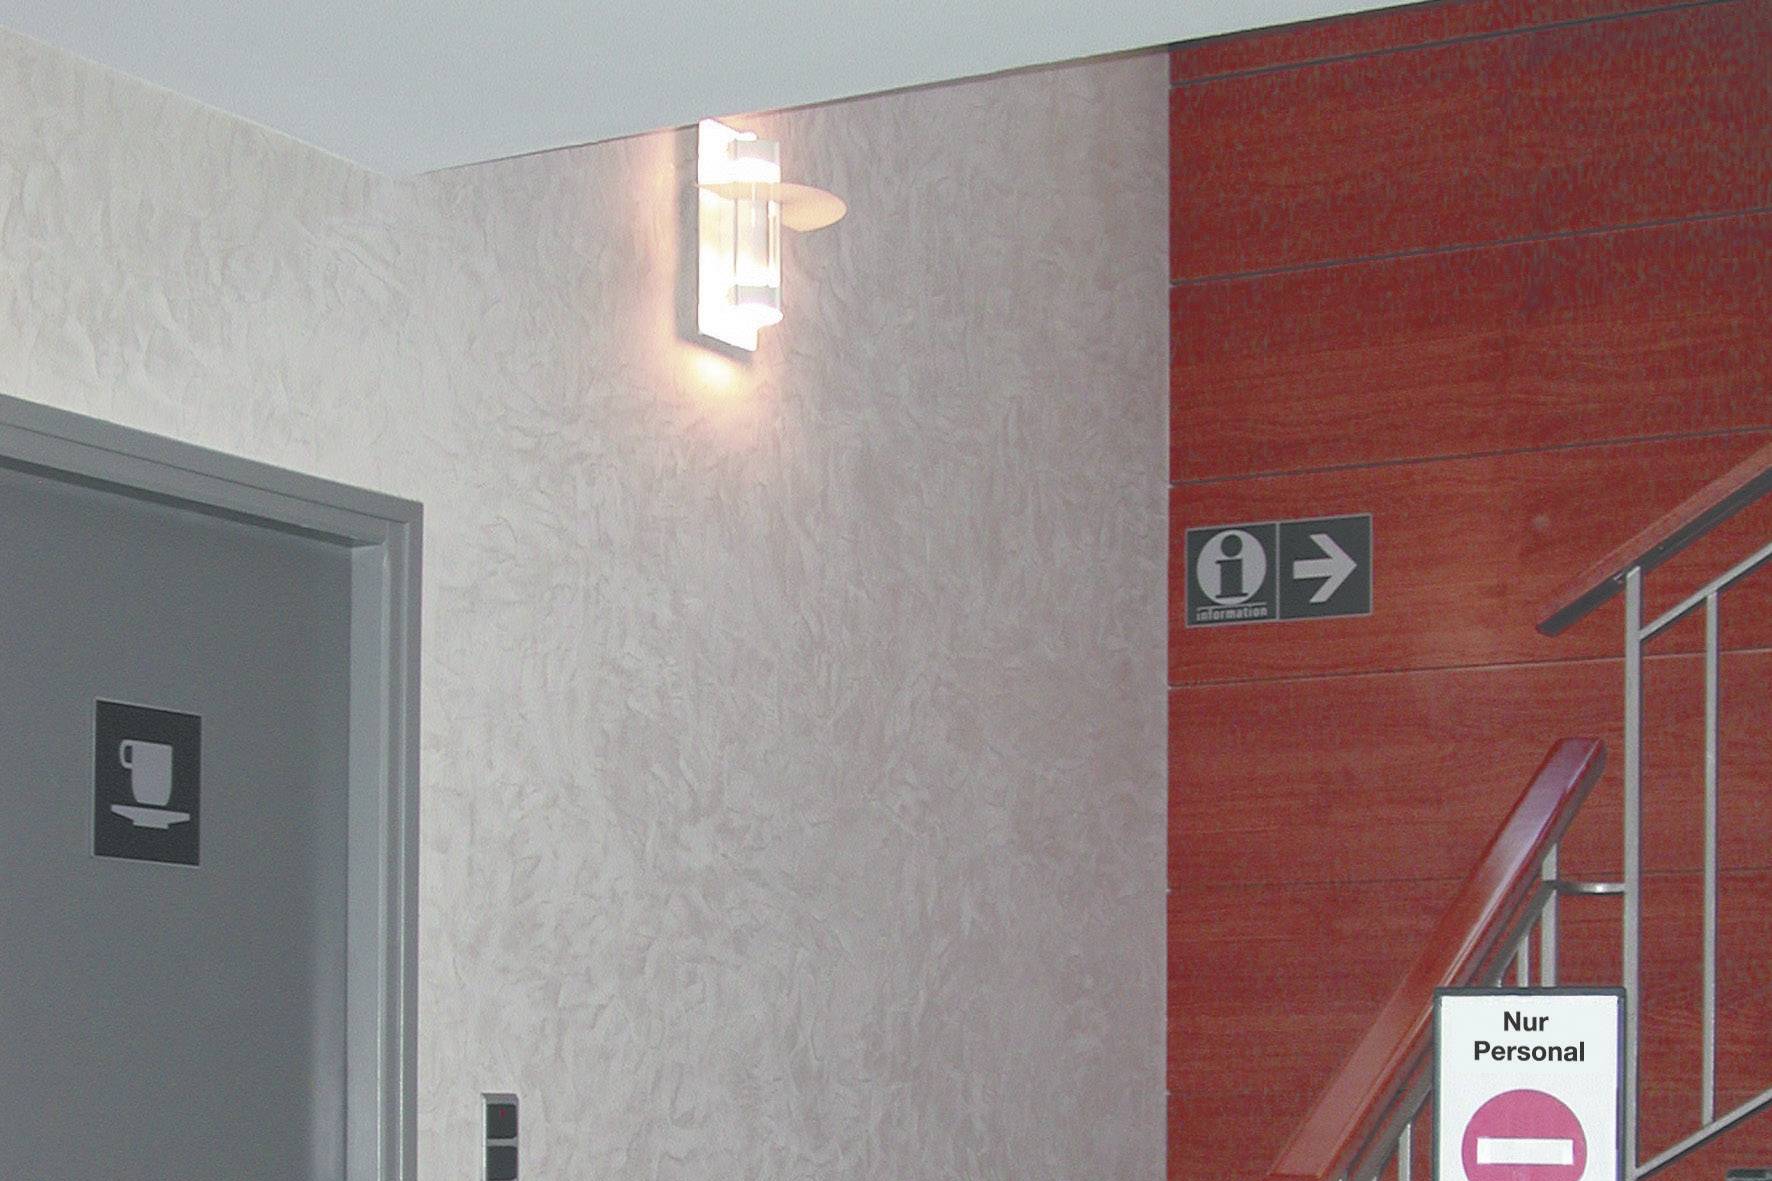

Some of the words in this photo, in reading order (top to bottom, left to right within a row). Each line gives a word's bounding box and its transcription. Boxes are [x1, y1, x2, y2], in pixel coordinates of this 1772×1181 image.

[1196, 606, 1268, 622] information
[1503, 1011, 1549, 1032] Nur
[1474, 1041, 1585, 1062] Personal
